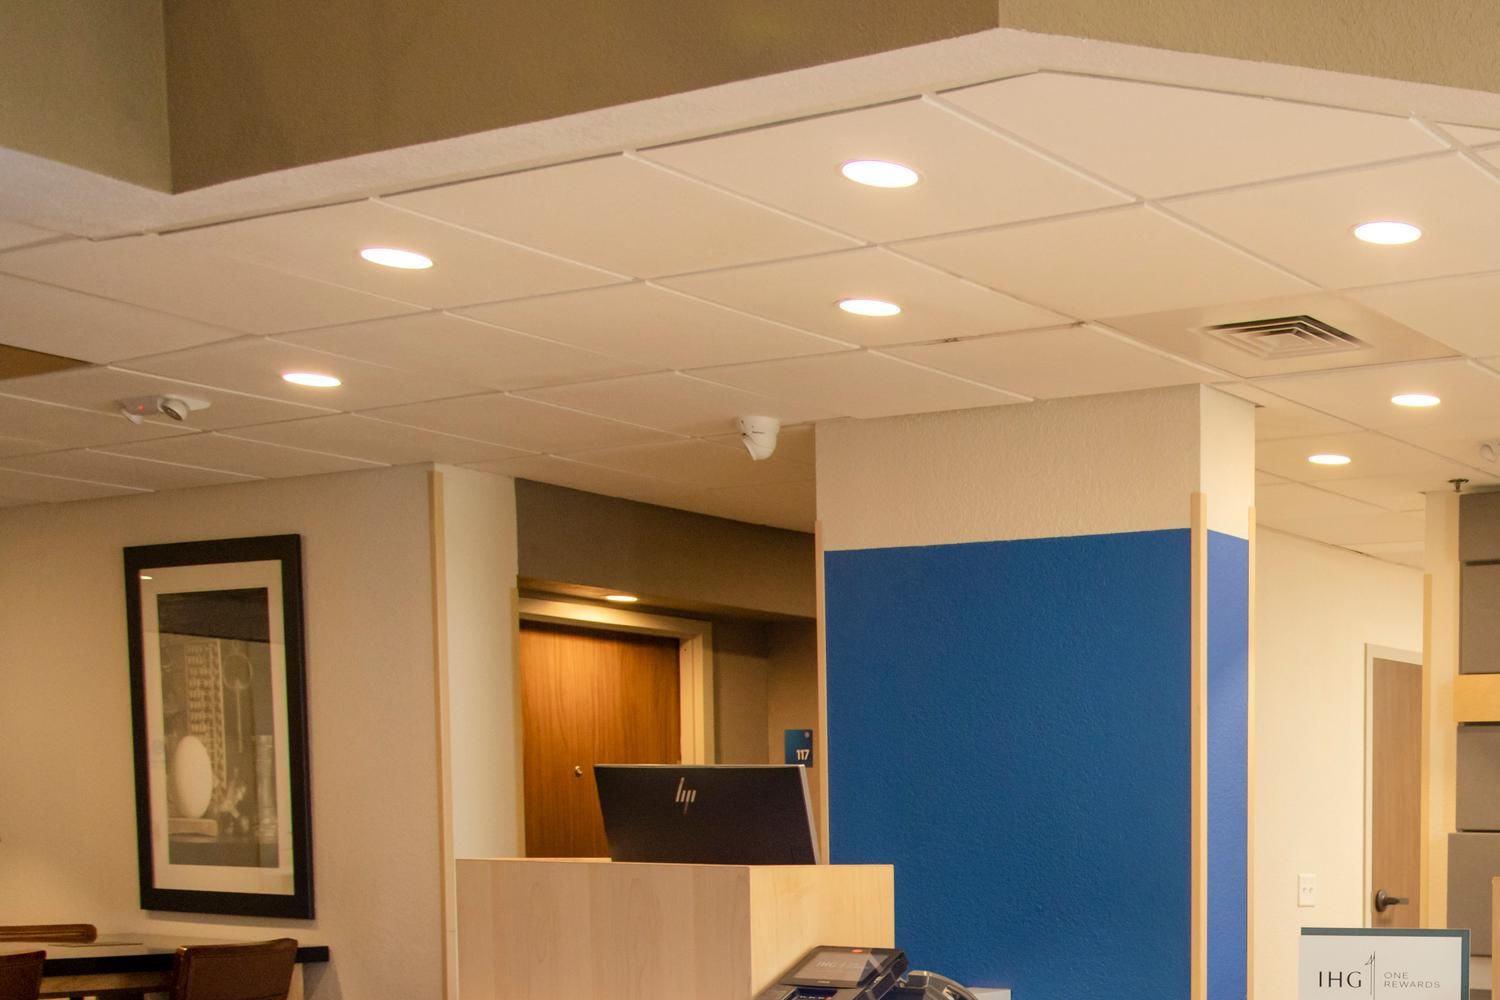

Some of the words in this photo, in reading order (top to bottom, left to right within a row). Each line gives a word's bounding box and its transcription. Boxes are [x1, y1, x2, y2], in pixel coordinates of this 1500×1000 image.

[796, 749, 810, 761] 117
[675, 776, 697, 816] hp
[1319, 970, 1362, 989] IHG
[1383, 971, 1409, 980] ONE
[1383, 980, 1441, 989] REWARDS
